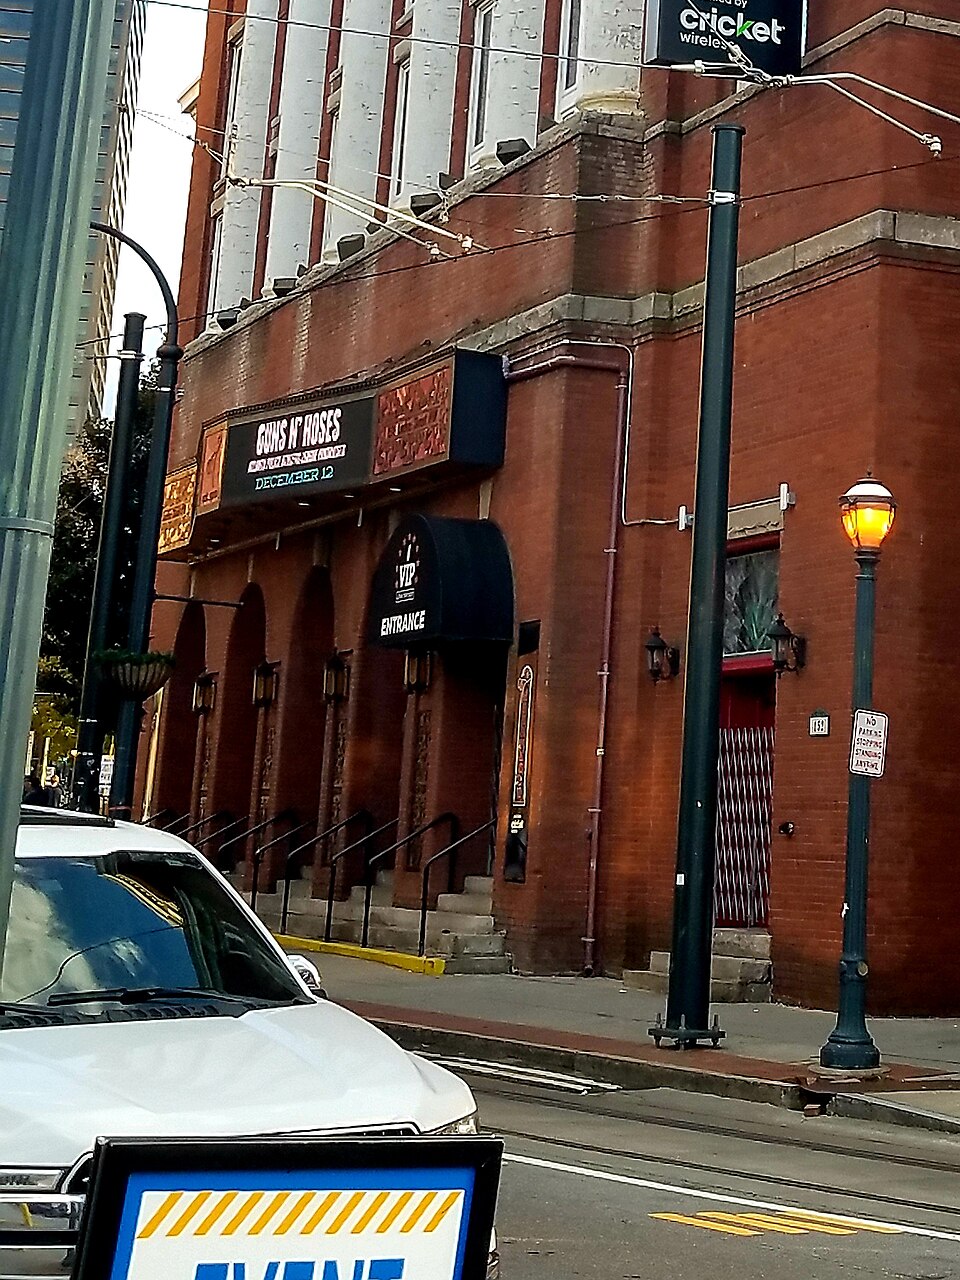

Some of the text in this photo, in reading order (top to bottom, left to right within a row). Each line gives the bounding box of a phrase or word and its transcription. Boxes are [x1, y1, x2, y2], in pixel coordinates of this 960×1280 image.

[679, 7, 783, 45] cricket
[256, 419, 289, 456] GUNS
[302, 408, 342, 447] HOSES
[255, 465, 335, 491] DECEMBER 12
[399, 562, 416, 588] VIP
[380, 609, 426, 637] ENTRANCE
[866, 718, 877, 726] NO
